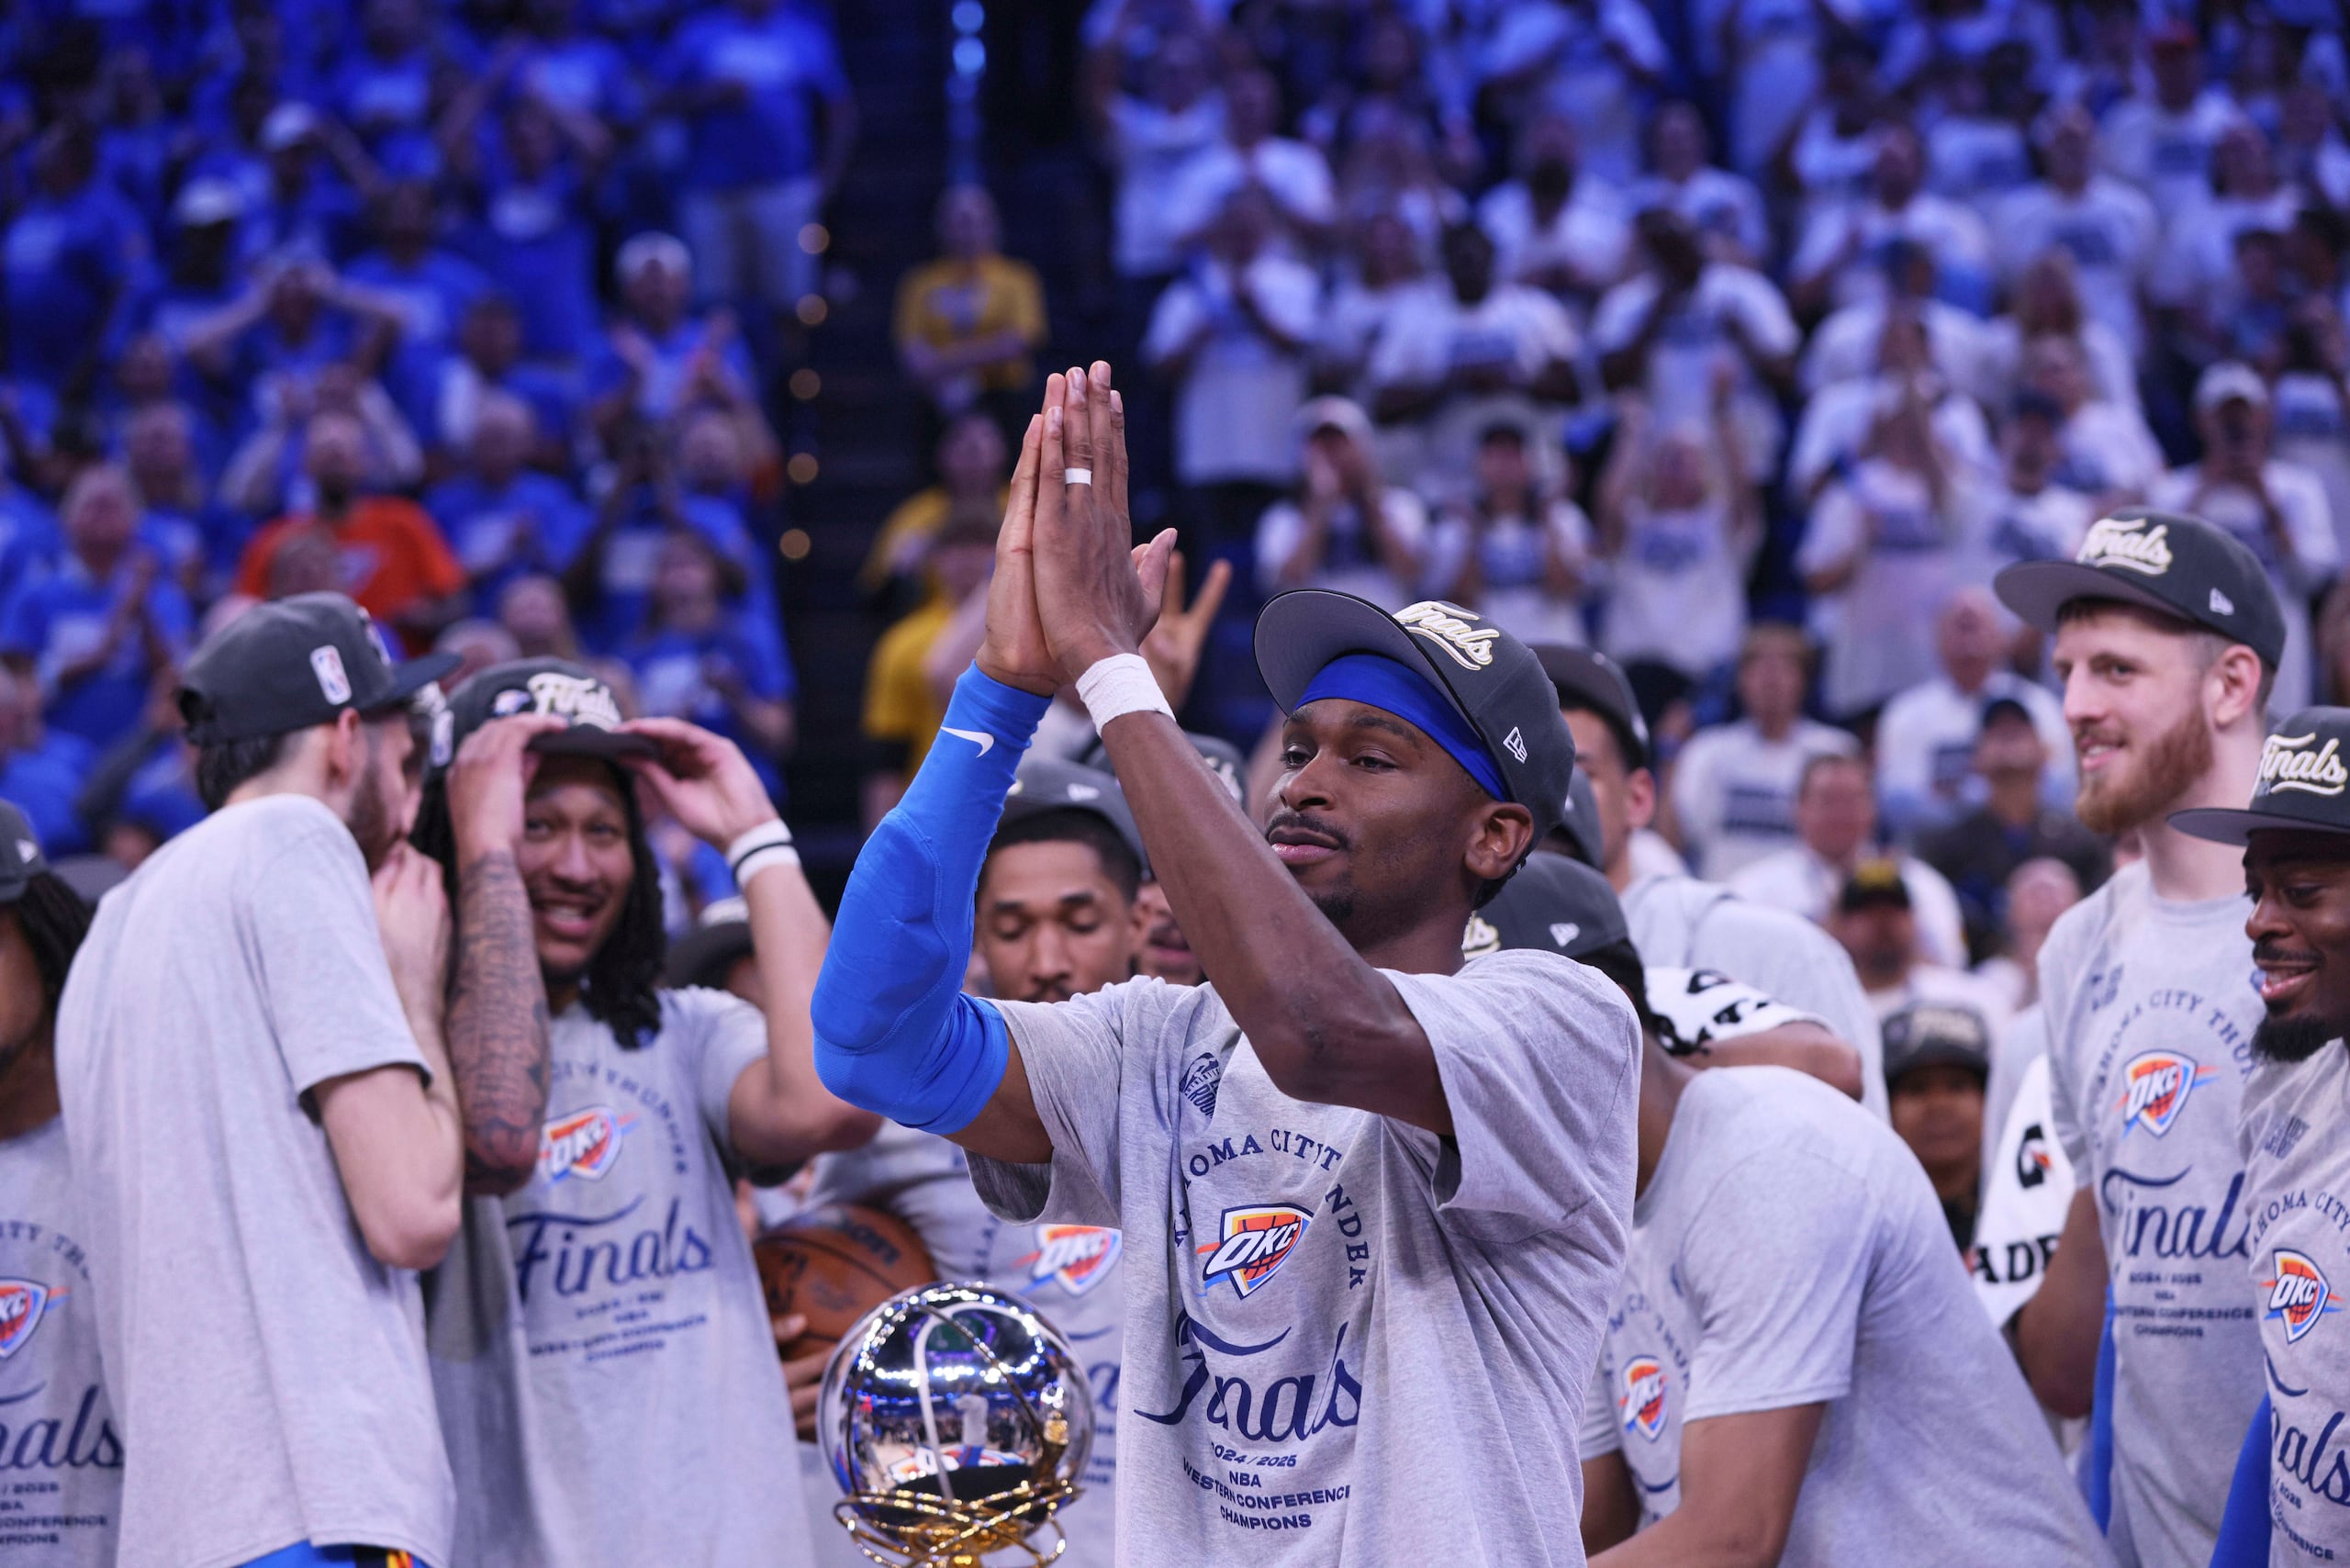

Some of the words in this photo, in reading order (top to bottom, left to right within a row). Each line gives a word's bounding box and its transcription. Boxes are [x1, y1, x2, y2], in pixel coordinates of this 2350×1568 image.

[2124, 1064, 2178, 1123] OKC
[506, 1194, 713, 1306] Finals
[1203, 1222, 1300, 1278] OKC
[2269, 1272, 2319, 1310] OKC
[1183, 1457, 1237, 1505] WESTERN
[1228, 1471, 1262, 1488] NBA
[1220, 1505, 1313, 1530] CHAMPIONS
